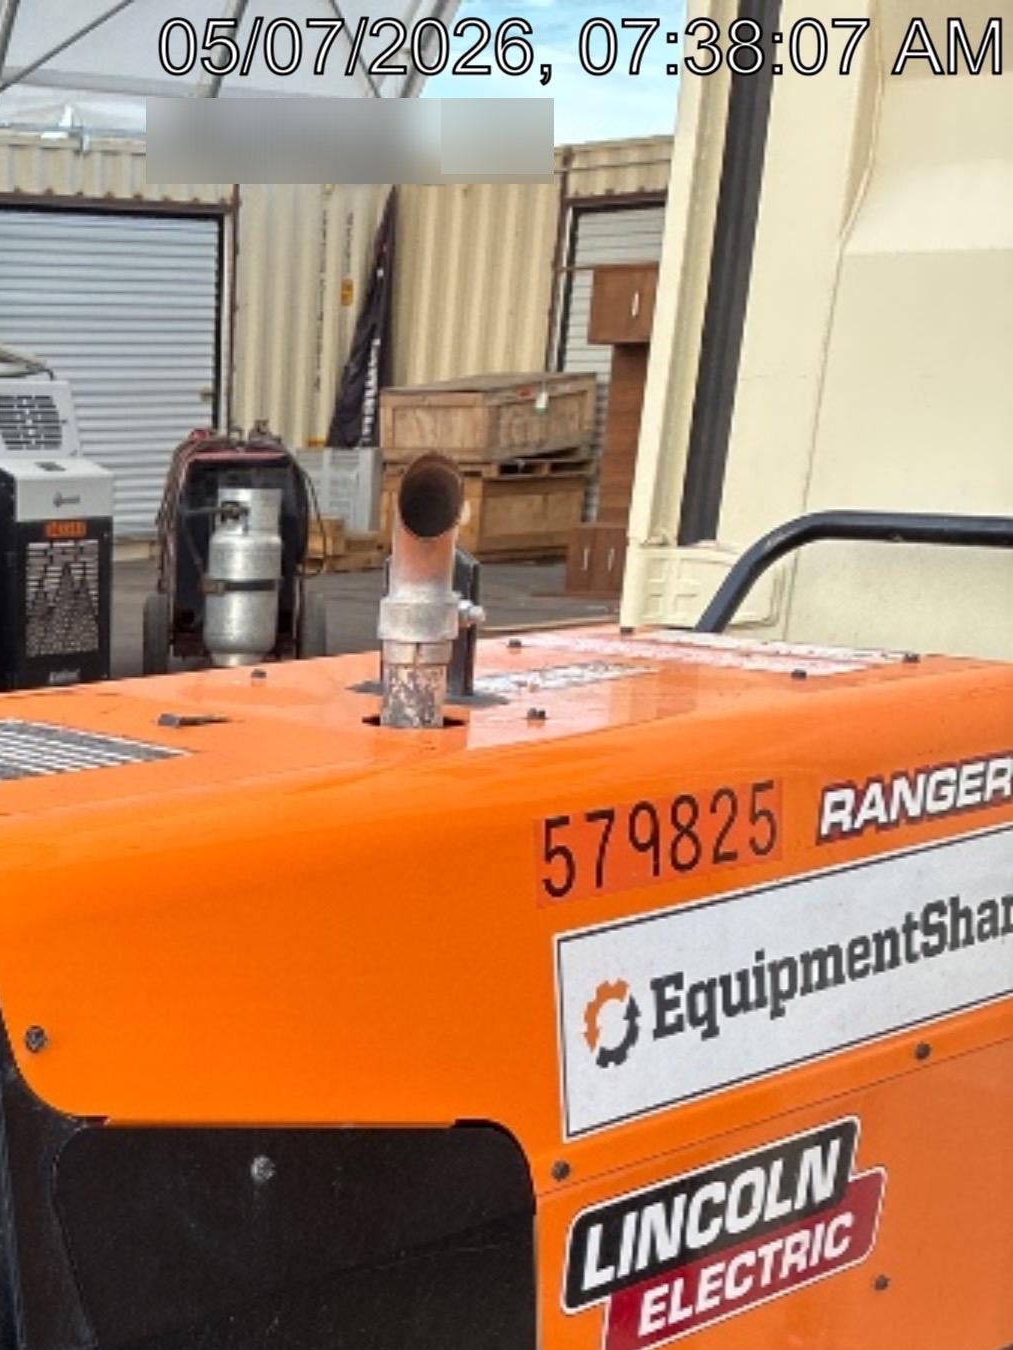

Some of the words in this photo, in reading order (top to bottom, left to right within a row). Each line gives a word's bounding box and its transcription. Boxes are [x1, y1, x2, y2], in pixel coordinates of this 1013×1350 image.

[542, 780, 778, 898] 579825
[818, 754, 1013, 840] RANGER
[581, 1138, 841, 1291] LINCOLN
[637, 1211, 854, 1338] ELECTRIC
